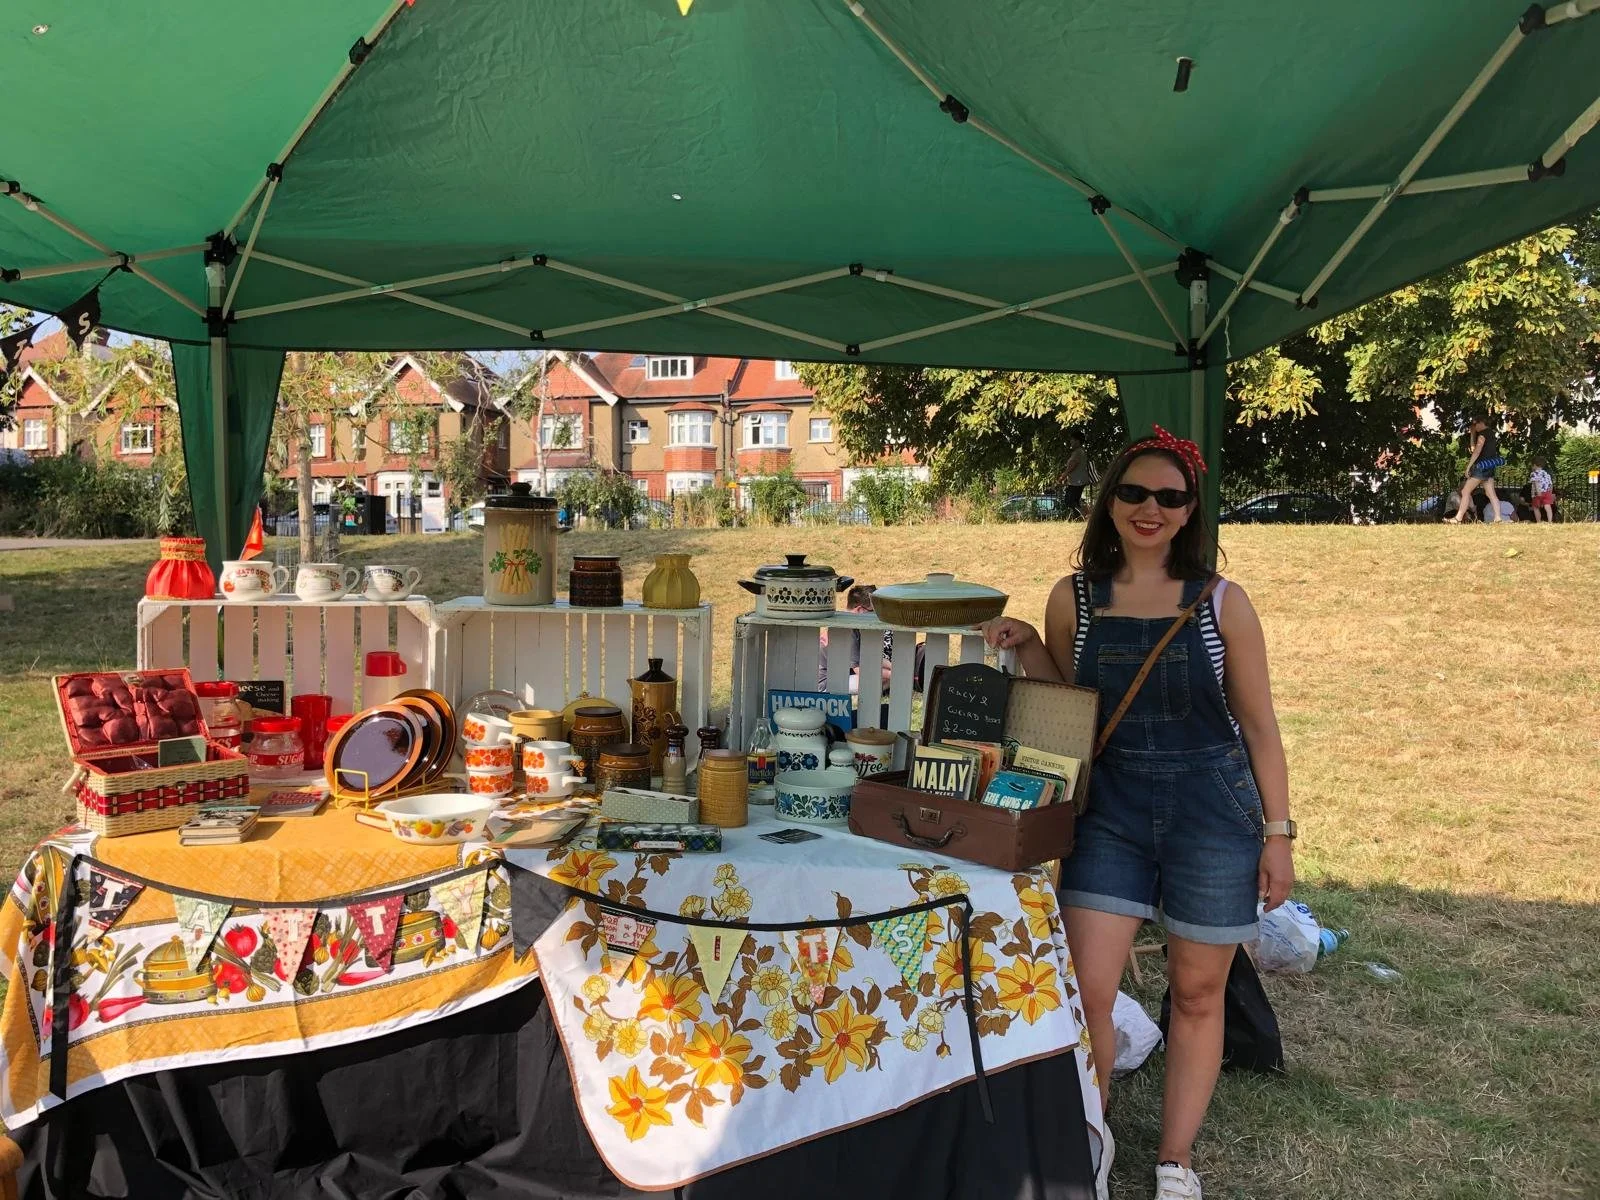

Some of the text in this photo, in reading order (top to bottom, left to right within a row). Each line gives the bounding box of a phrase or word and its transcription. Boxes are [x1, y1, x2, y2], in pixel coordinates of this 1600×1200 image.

[79, 312, 90, 335] S
[383, 568, 403, 579] BROTH
[771, 695, 850, 717] HANCOCK
[854, 761, 884, 777] offee
[912, 760, 970, 792] MALAY
[984, 791, 1033, 810] THE GUNS OF
